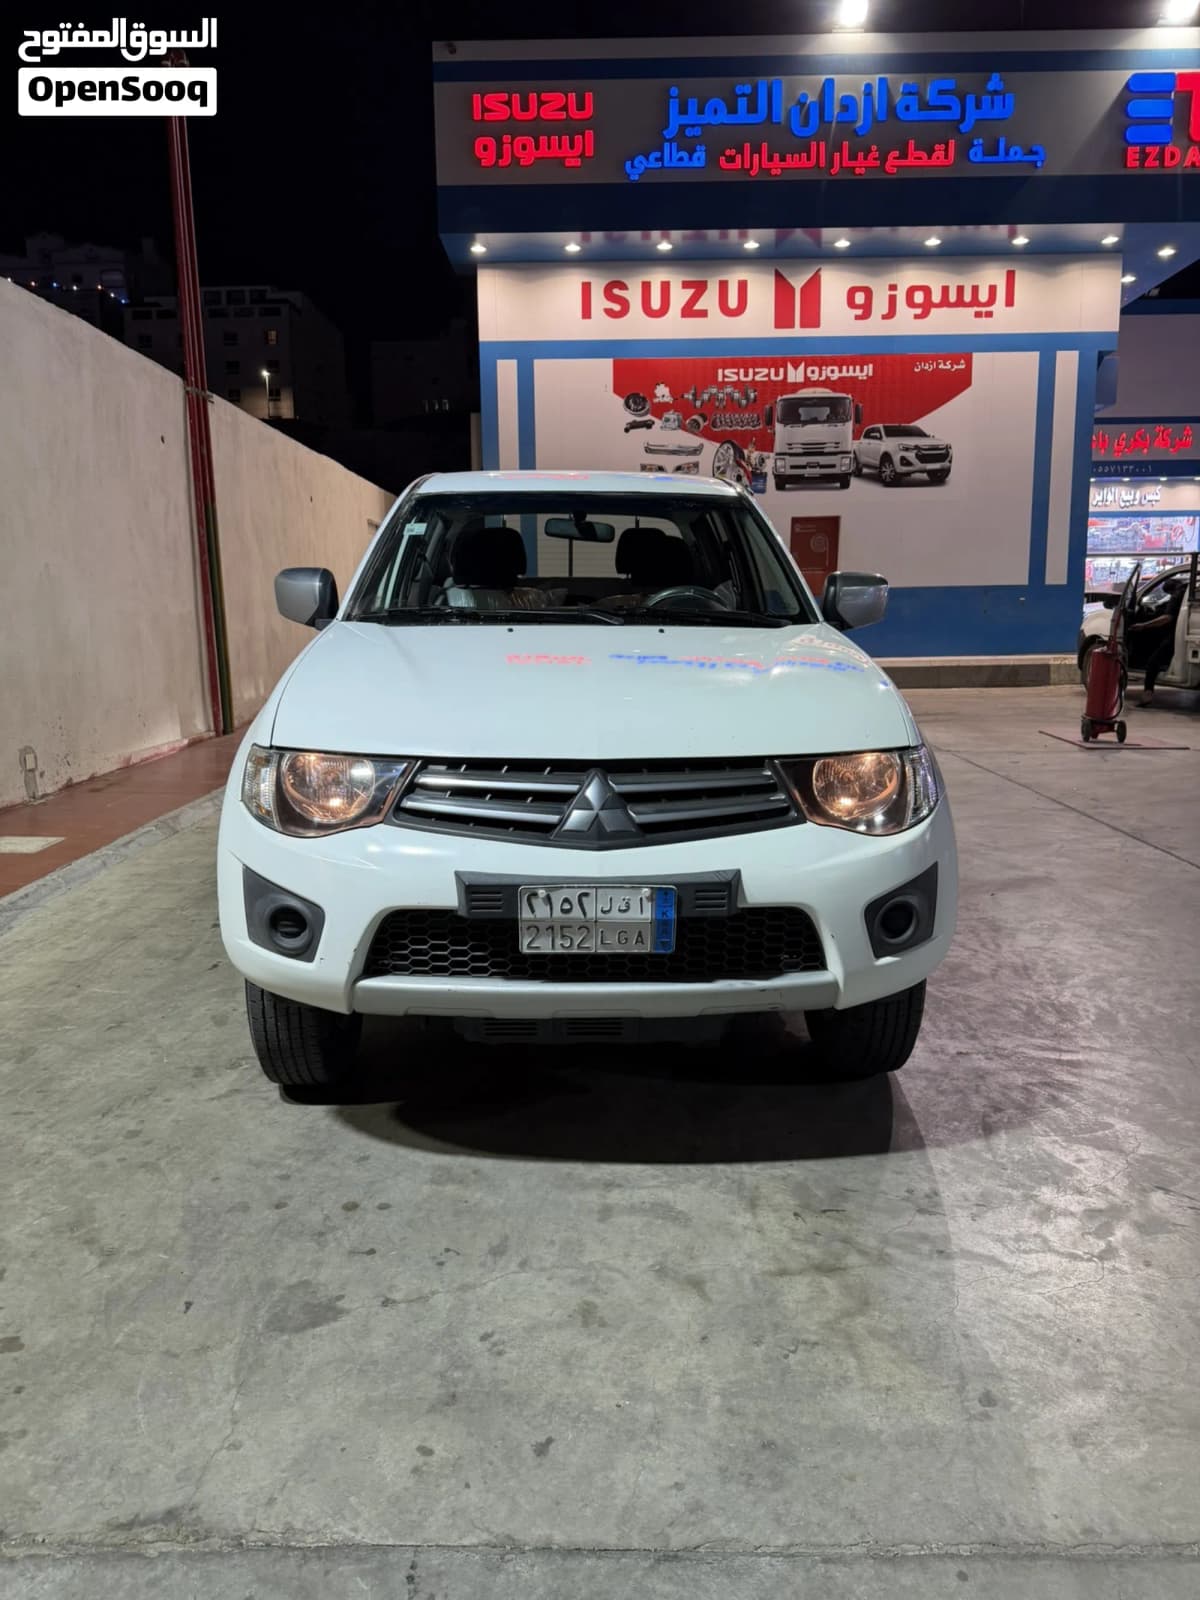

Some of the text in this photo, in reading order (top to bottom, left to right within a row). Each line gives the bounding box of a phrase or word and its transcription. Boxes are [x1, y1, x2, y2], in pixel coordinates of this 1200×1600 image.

[472, 92, 594, 121] ISUZU
[663, 73, 1015, 139] شركة ازدان التميز
[473, 129, 594, 168] ايسوزو
[624, 137, 1046, 180] جملة لقطع غيار السيارات قطاعي
[581, 279, 748, 320] ISUZU
[846, 270, 1016, 321] ايسوزو
[718, 367, 784, 382] ISUZU
[806, 363, 873, 382] ايسوزو
[938, 360, 966, 373] شركة
[1152, 425, 1193, 455] شركة
[526, 891, 591, 919] ٢١٥٢
[526, 924, 645, 950] 2152 LGA
